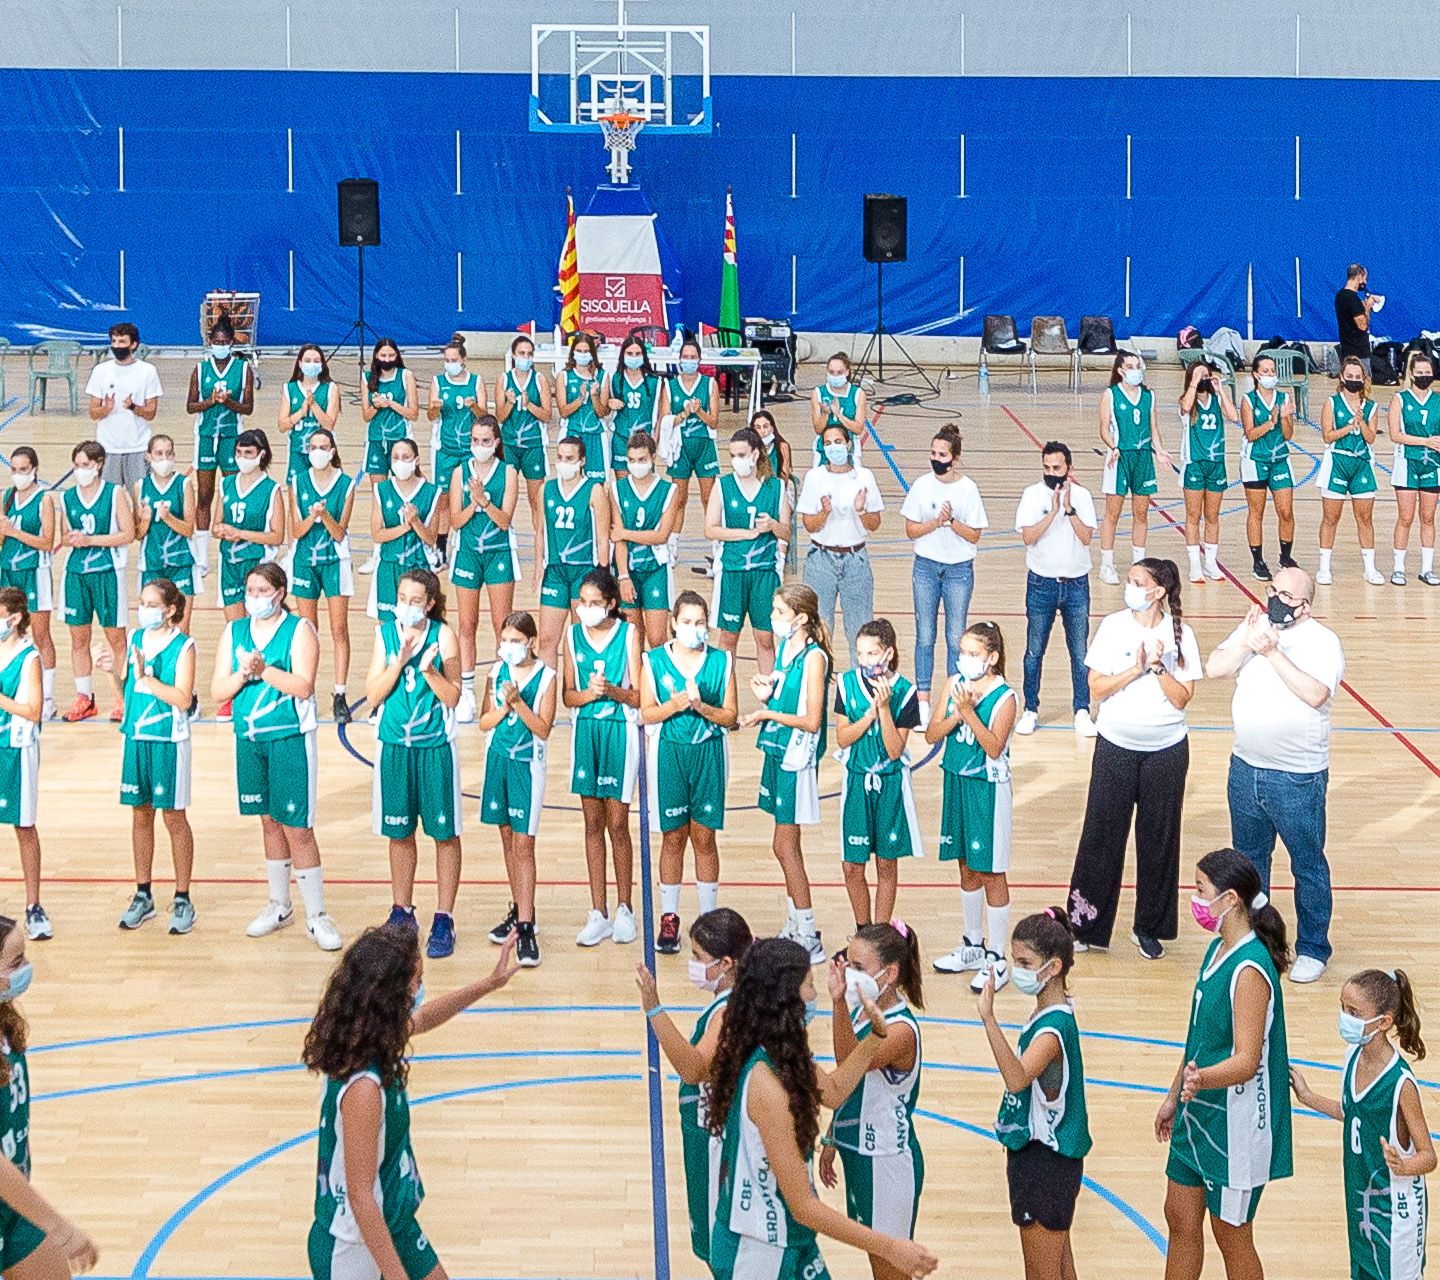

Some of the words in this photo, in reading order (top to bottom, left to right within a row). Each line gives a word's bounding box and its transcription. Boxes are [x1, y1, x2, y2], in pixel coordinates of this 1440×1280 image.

[580, 300, 651, 313] SISQUELLA
[456, 396, 464, 409] 9
[628, 392, 641, 408] 35
[1132, 408, 1141, 425] 8
[1201, 414, 1216, 429] 22
[1420, 410, 1428, 425] 7
[230, 502, 246, 523] 15
[555, 506, 574, 528] 22
[636, 507, 645, 528] 9
[79, 514, 97, 534] 30
[405, 666, 416, 692] 3
[597, 776, 617, 786] CBFC
[665, 806, 687, 817] CBFC
[385, 816, 408, 825] CBFC
[848, 836, 869, 845] CBFC
[865, 1122, 876, 1152] CBF
[1351, 1117, 1362, 1154] 6
[740, 1178, 751, 1211] CBF
[1398, 1191, 1408, 1218] CBF
